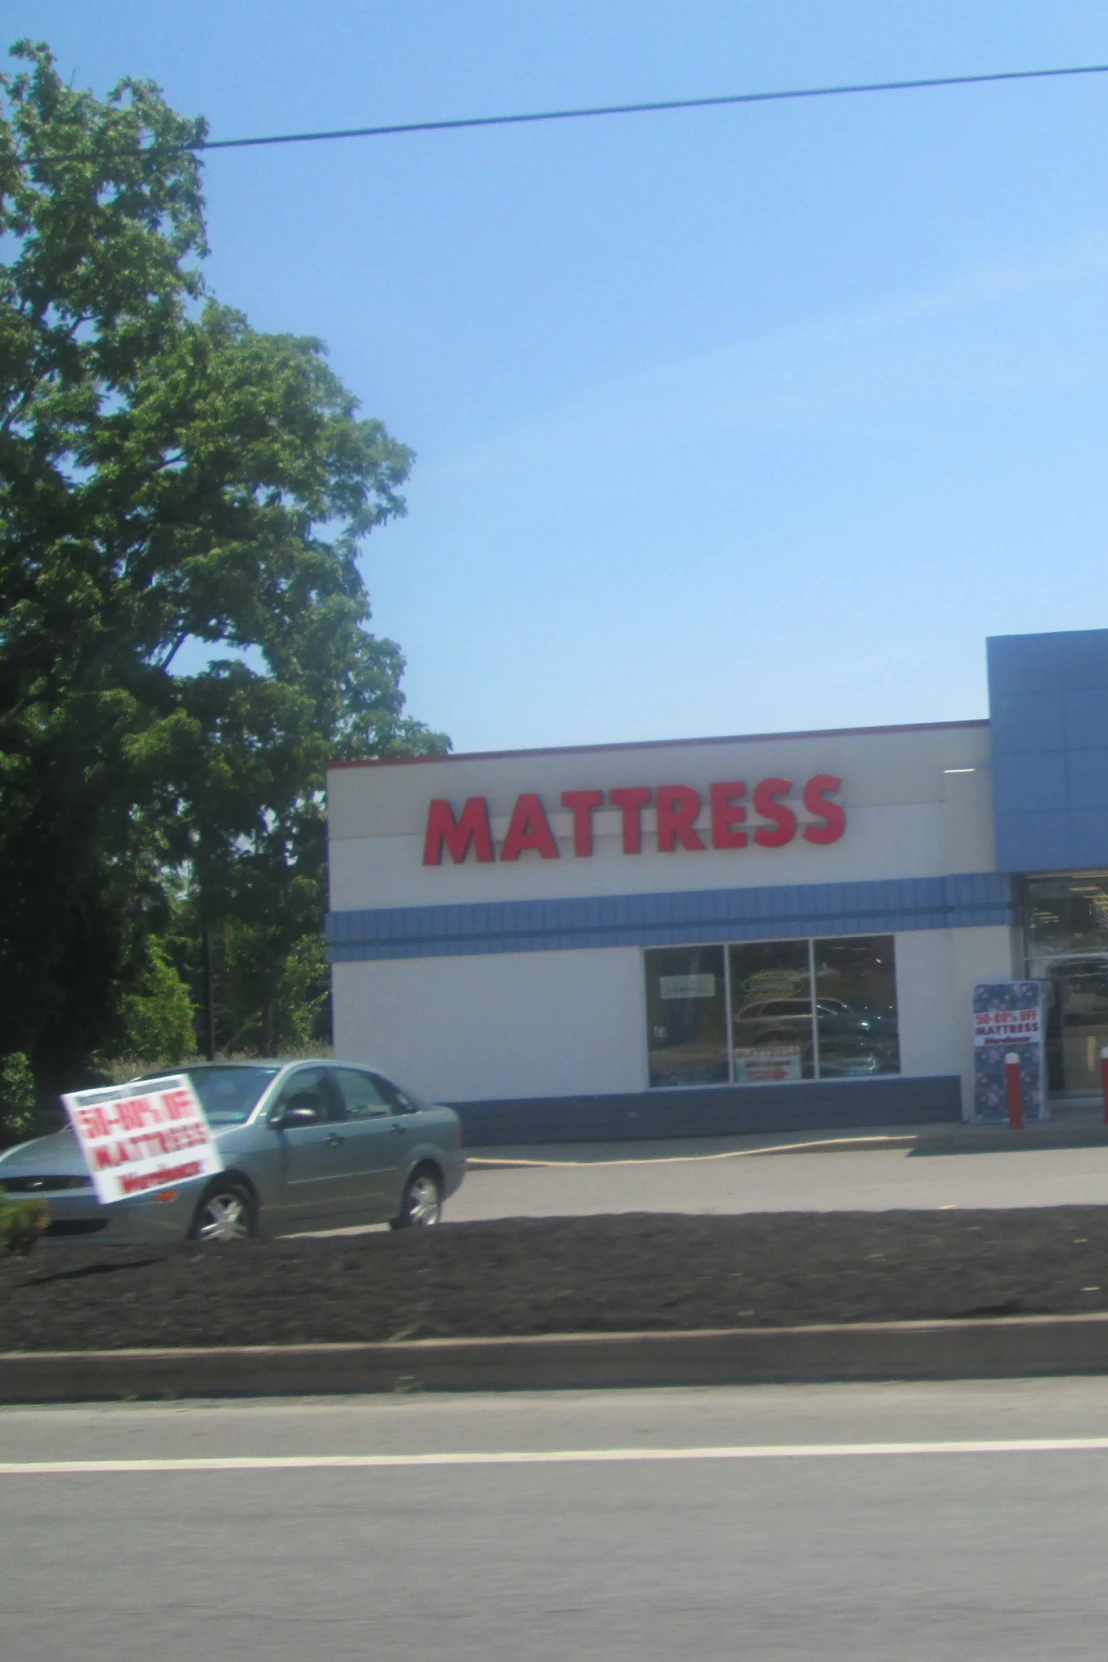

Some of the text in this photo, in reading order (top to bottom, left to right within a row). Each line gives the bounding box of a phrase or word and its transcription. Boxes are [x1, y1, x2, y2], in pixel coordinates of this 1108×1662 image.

[422, 774, 847, 866] MATTRESS
[975, 1022, 1039, 1035] MATTRESS
[1020, 1009, 1038, 1021] OFF
[91, 1122, 209, 1170] MATTRESS
